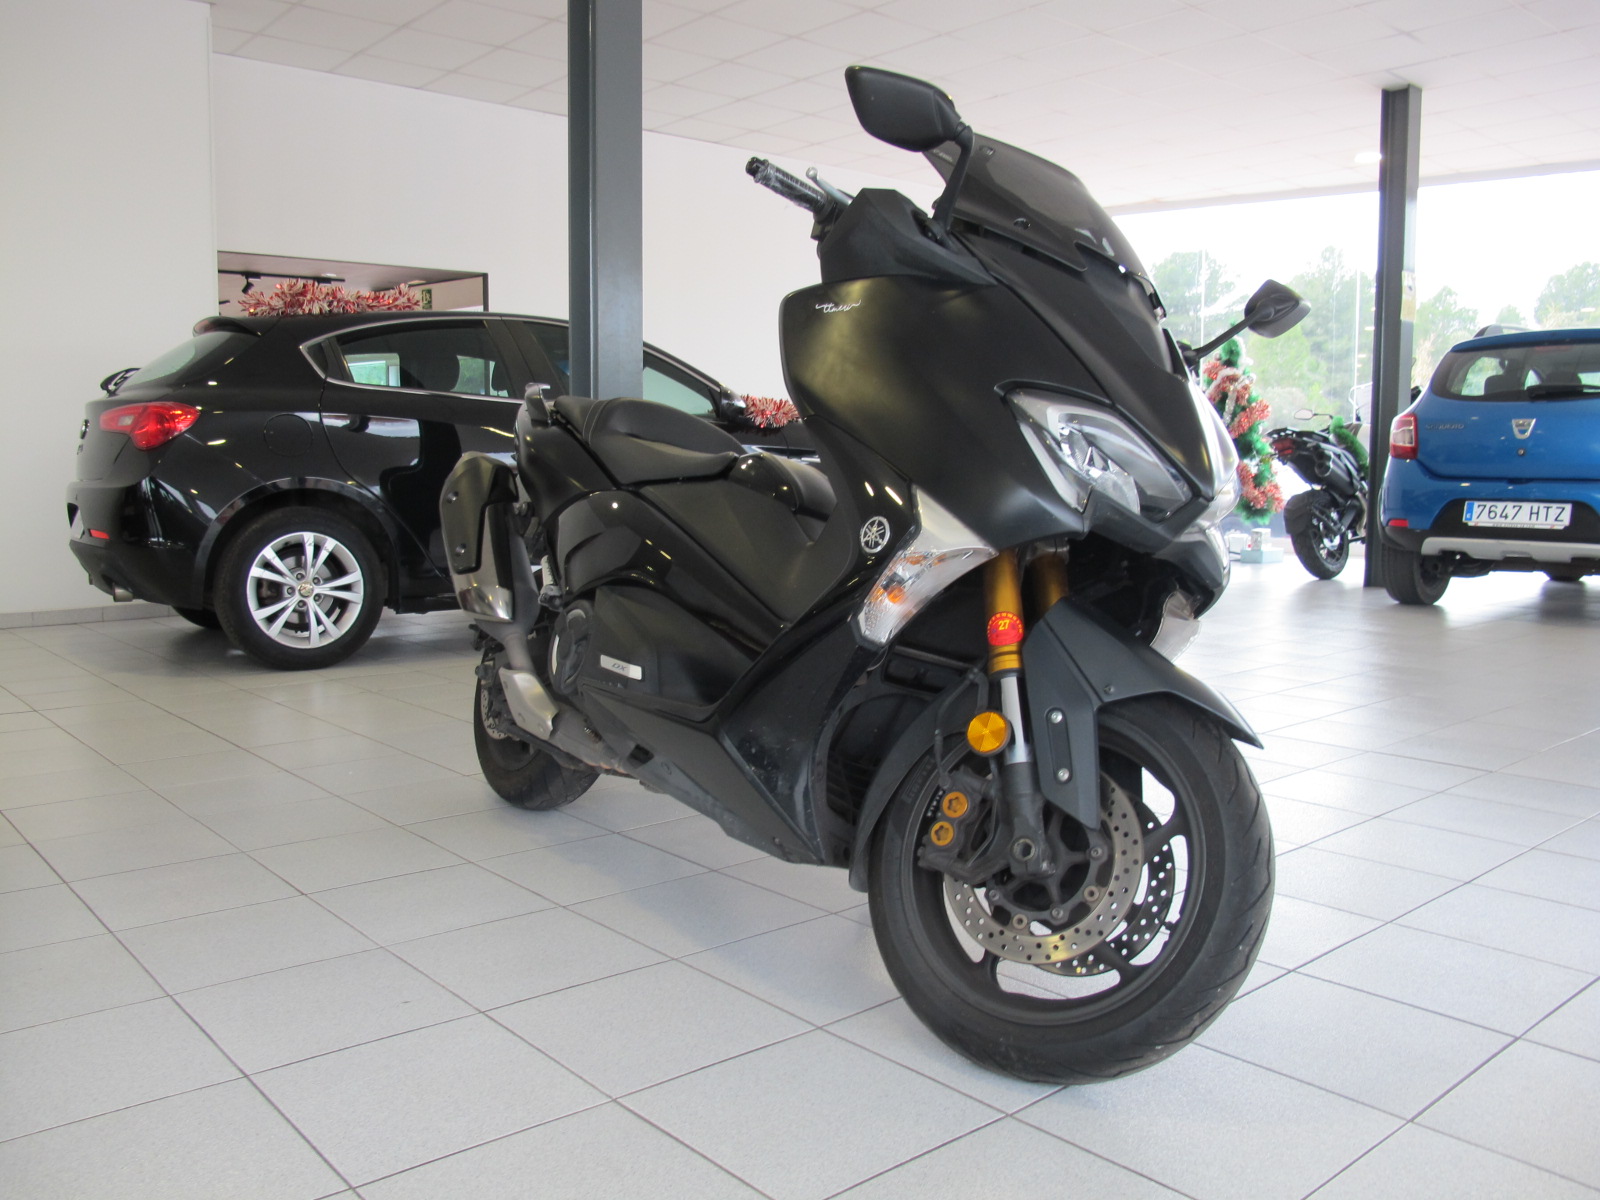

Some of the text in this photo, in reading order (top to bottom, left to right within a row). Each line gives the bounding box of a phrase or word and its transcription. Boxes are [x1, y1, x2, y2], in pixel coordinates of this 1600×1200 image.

[1476, 504, 1566, 522] 7647 HTZ
[612, 663, 628, 671] DX
